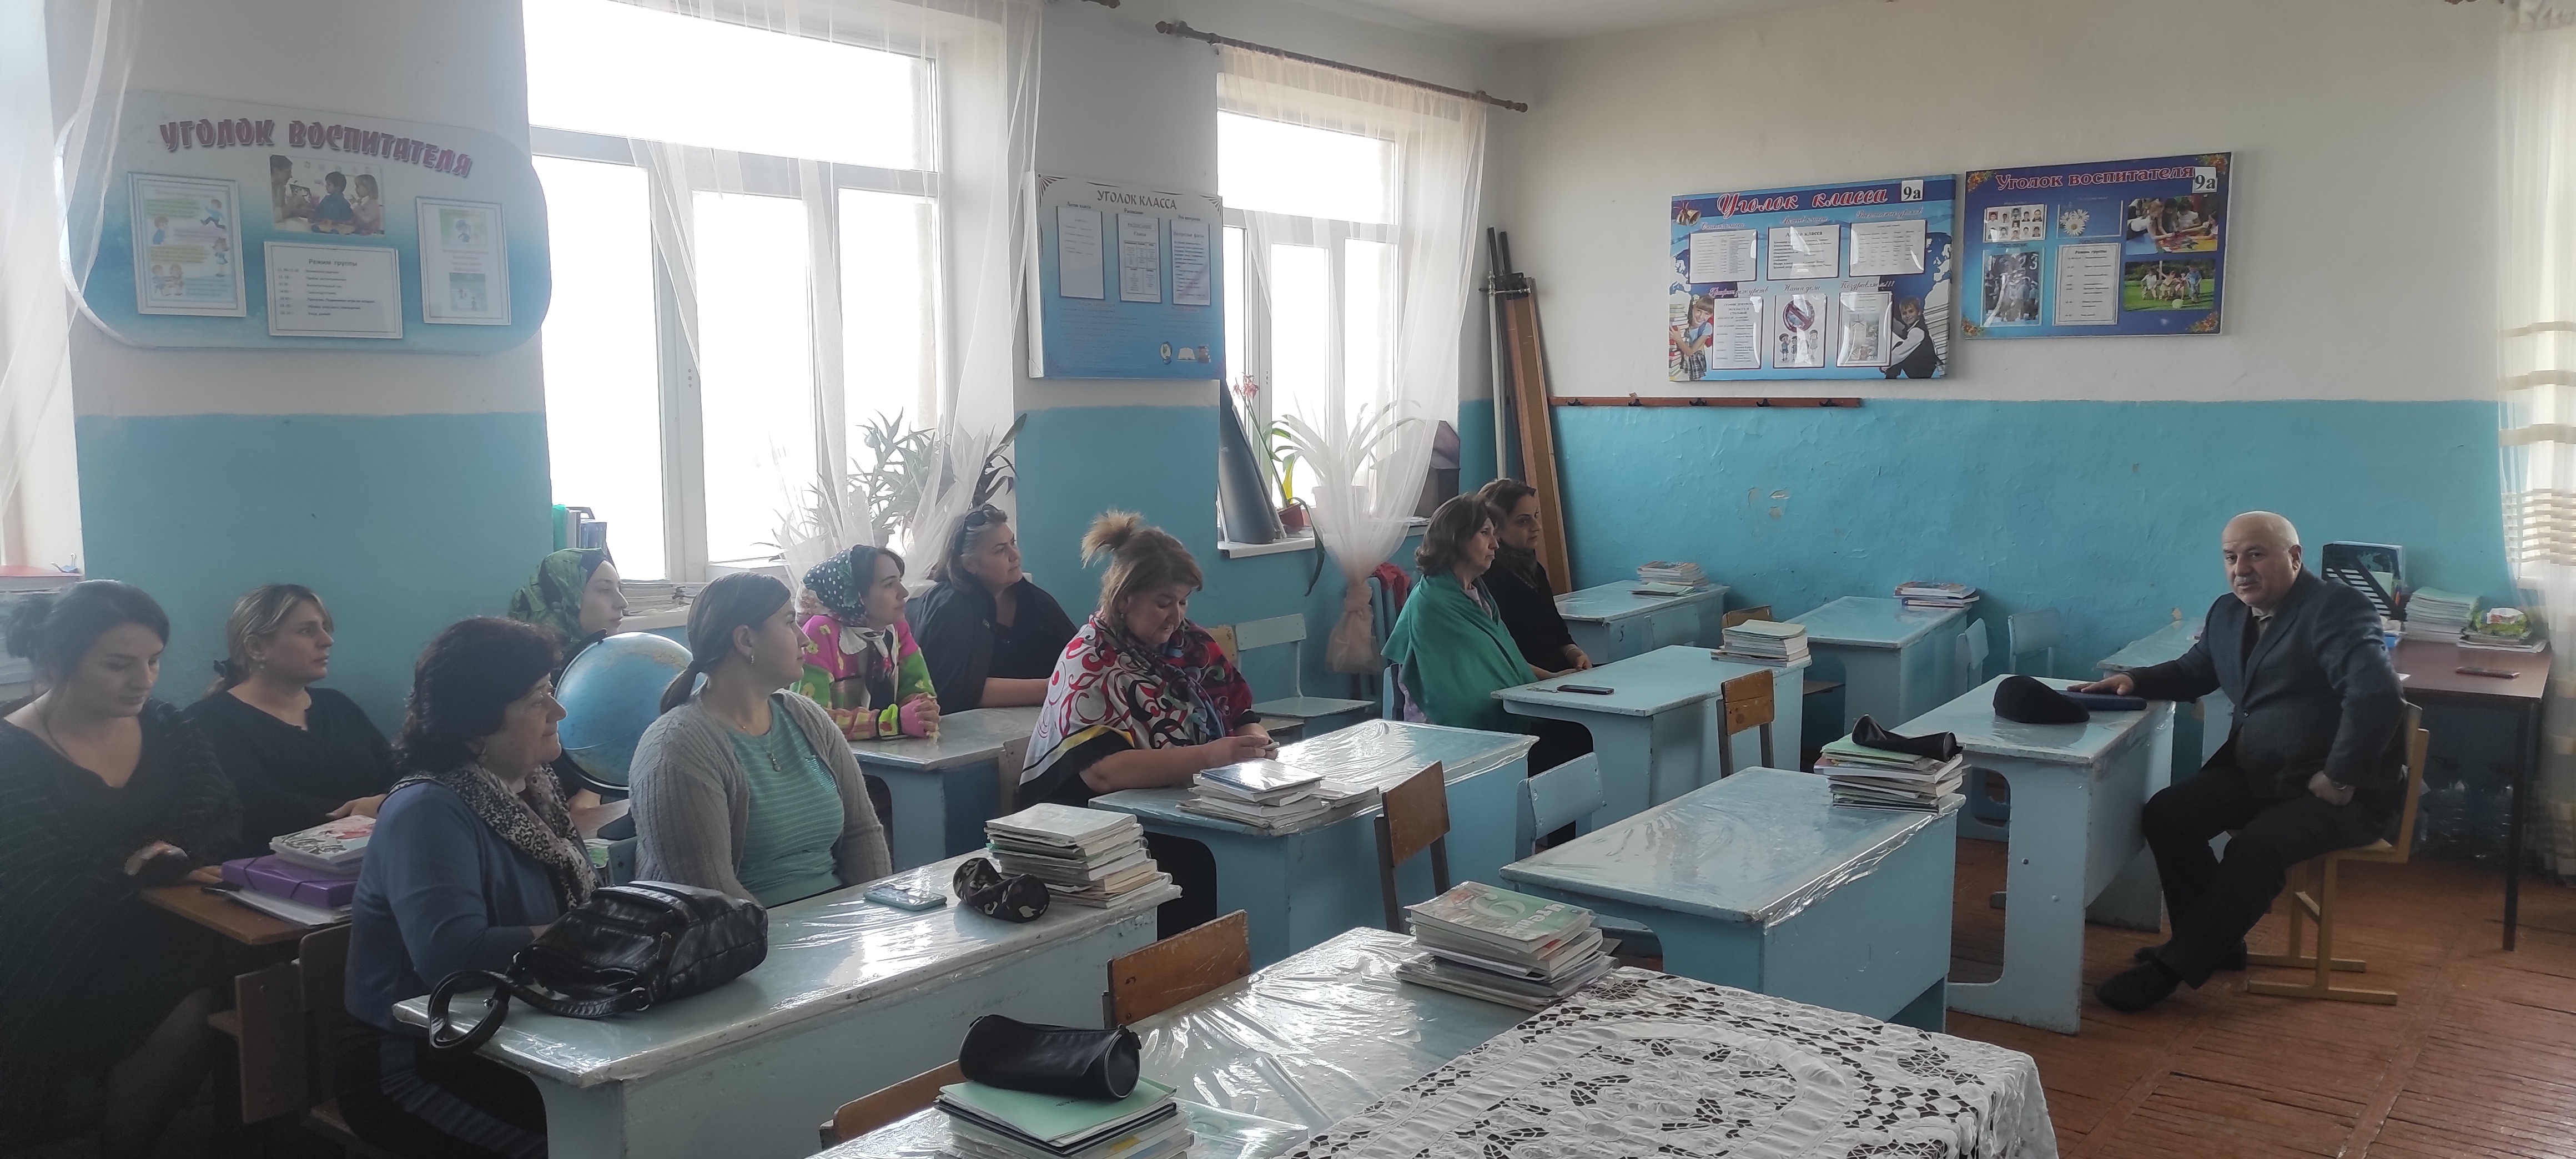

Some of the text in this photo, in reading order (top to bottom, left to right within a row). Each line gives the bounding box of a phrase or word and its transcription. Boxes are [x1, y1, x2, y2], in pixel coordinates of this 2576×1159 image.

[159, 118, 472, 178] УГОЛОК ВОСПИТАТЕЛЯ
[1995, 166, 2196, 191] Уголок воспитателя
[2195, 173, 2216, 190] 9а
[1097, 190, 1178, 210] УГОЛОК КЛАССА
[1717, 187, 1889, 219] Уголок класса
[1903, 186, 1921, 200] 9а
